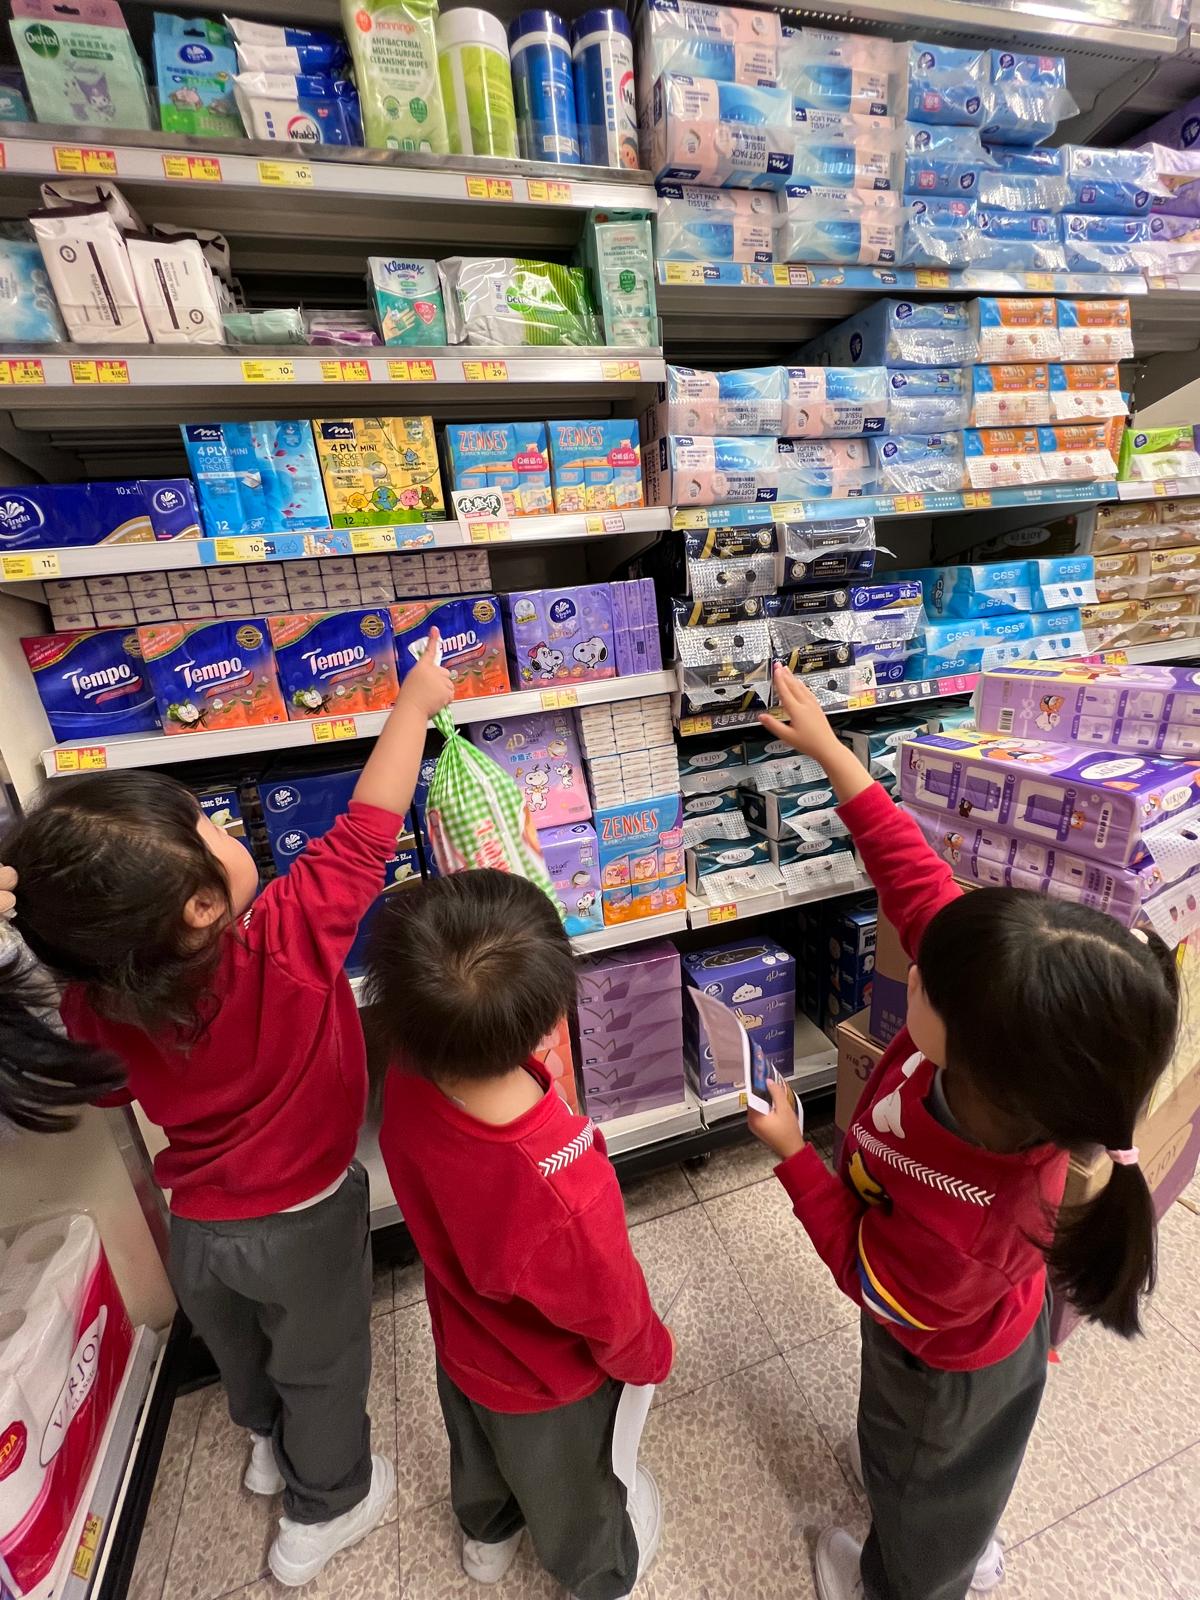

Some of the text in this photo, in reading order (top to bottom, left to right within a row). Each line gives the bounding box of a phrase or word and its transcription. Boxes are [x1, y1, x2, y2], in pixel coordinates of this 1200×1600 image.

[26, 31, 59, 47] Dettol
[372, 47, 425, 59] MULTI-SURFACE
[370, 55, 429, 70] CLEANSING WIPES
[289, 125, 320, 142] Walch
[296, 170, 306, 178] 10
[686, 192, 721, 202] SOFT PACK
[687, 200, 710, 208] TISSUE
[384, 260, 424, 276] Kleenex
[691, 269, 700, 277] 23
[279, 366, 289, 375] 10
[492, 369, 502, 377] 29
[458, 430, 508, 453] ZENSES
[558, 427, 604, 448] ZENSES
[197, 446, 249, 457] 4 PLY MINI
[330, 443, 378, 453] 4 PLY MINI
[332, 452, 364, 462] POCKET
[200, 464, 232, 472] TISSUE
[333, 460, 362, 468] TISSUE
[1, 513, 31, 529] Vinda
[216, 520, 230, 531] 12
[343, 516, 354, 525] 12
[382, 533, 392, 542] 10
[250, 544, 259, 552] 10
[42, 559, 51, 568] 11
[1059, 564, 1082, 574] C&S
[992, 571, 1015, 581] C&S
[1047, 618, 1069, 627] C&S
[996, 625, 1019, 635] C&S
[439, 630, 478, 655] empo
[301, 645, 365, 676] Tempo
[941, 659, 965, 670] C&S
[174, 657, 243, 689] Tempo
[62, 663, 132, 697] Tempo
[889, 731, 912, 742] VIRJOY
[694, 753, 722, 763] VIRJOY
[214, 796, 231, 806] Blue
[802, 793, 828, 803] VIRJOY
[1165, 788, 1191, 804] VIRJOY
[690, 799, 718, 809] VIRJOY
[601, 810, 658, 842] ZENSES
[801, 840, 827, 851] VIRJOY
[721, 851, 749, 861] VIRJOY
[854, 1055, 874, 1082] 3
